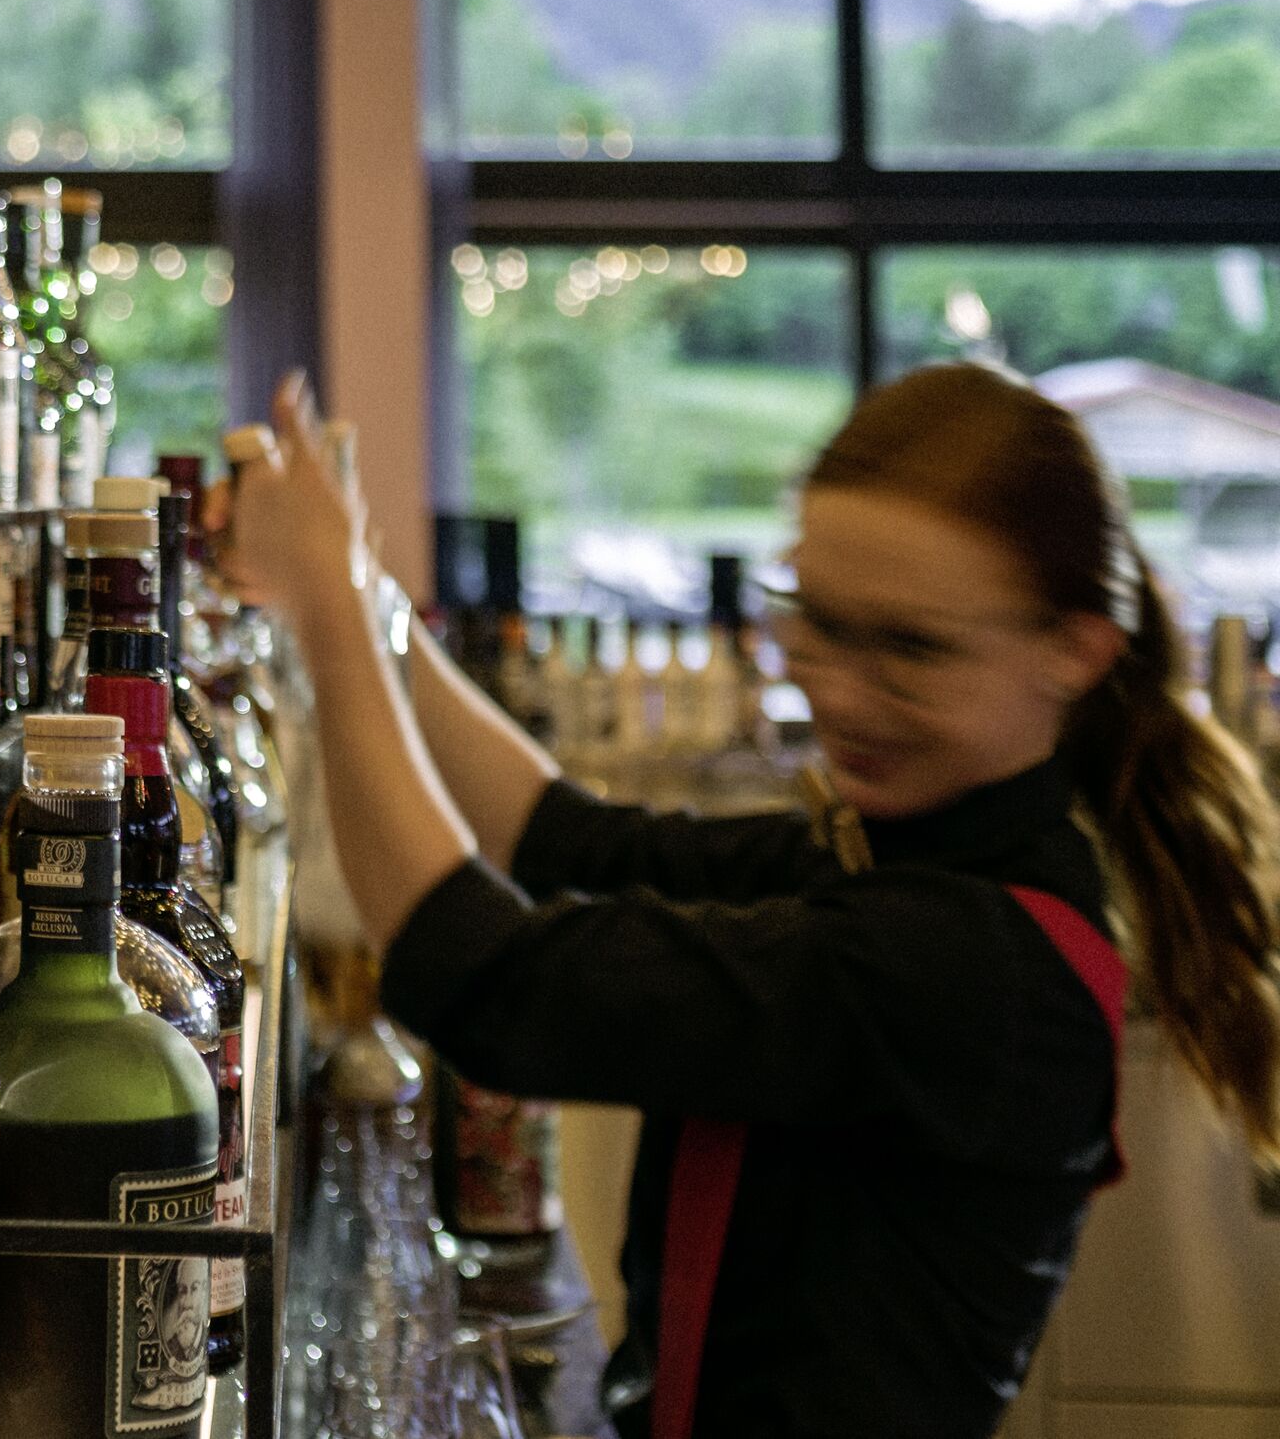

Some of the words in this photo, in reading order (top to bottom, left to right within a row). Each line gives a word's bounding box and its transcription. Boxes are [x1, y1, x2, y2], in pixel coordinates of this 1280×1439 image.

[27, 873, 79, 884] BOTUCAL
[35, 912, 73, 924] RESERVA
[31, 922, 79, 935] EXCLUSIVA
